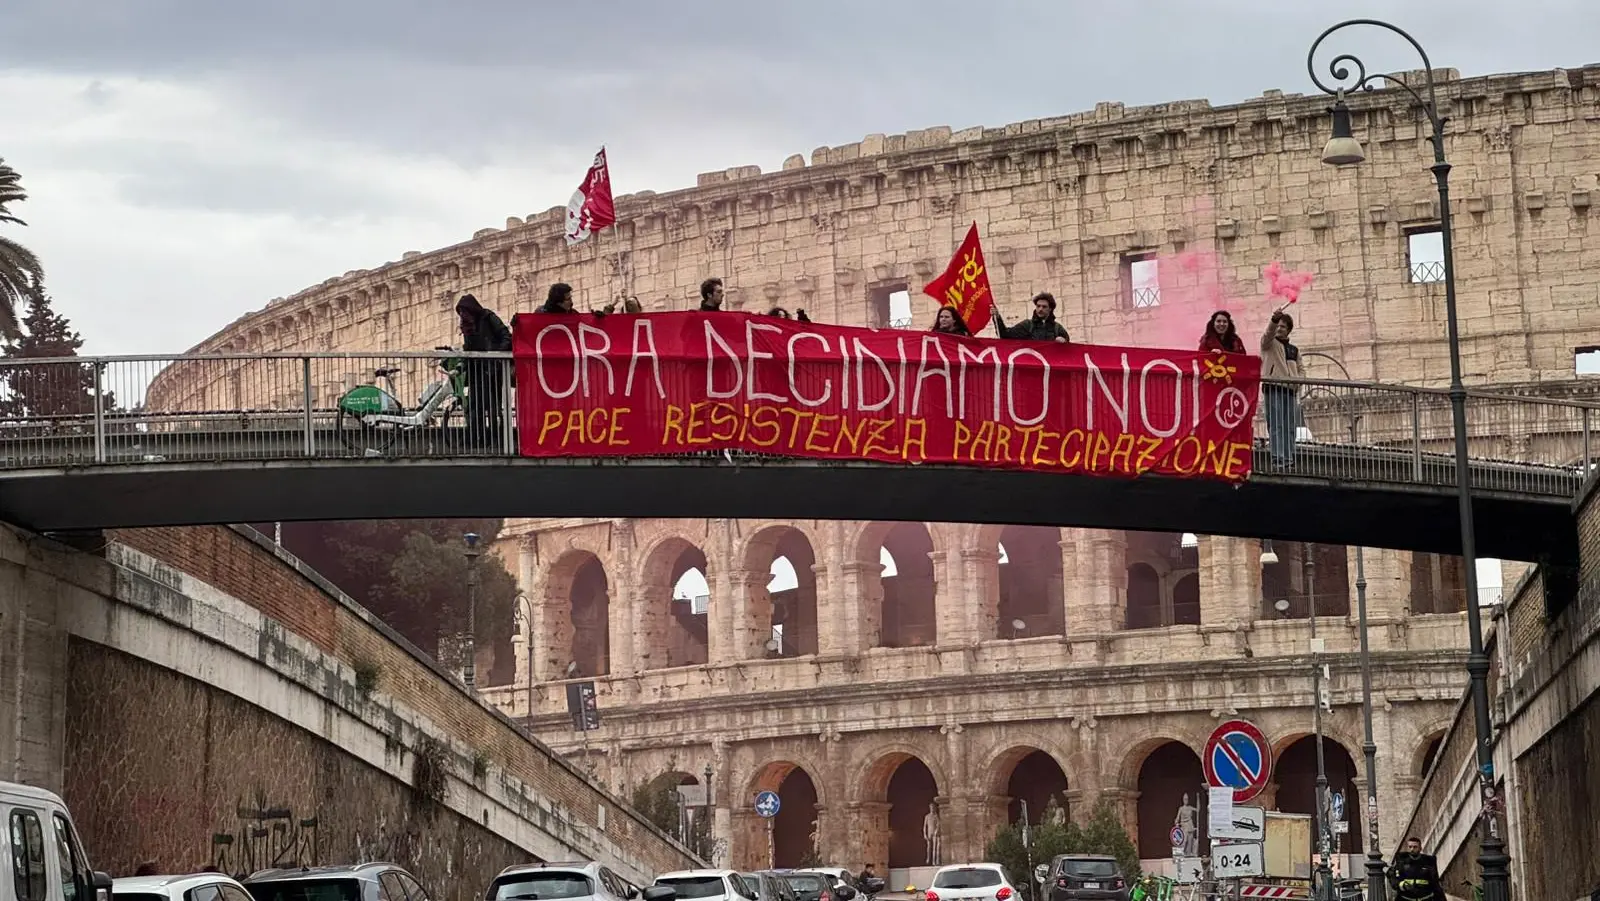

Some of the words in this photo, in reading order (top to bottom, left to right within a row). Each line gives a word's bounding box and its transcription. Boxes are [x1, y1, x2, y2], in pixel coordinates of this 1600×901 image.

[536, 318, 666, 399] ORA
[703, 318, 1051, 426] DECIDIAMO
[1083, 352, 1201, 438] NOI
[537, 407, 631, 447] PACE
[662, 400, 928, 461] RESISTENZA
[1221, 853, 1251, 868] 0-24
